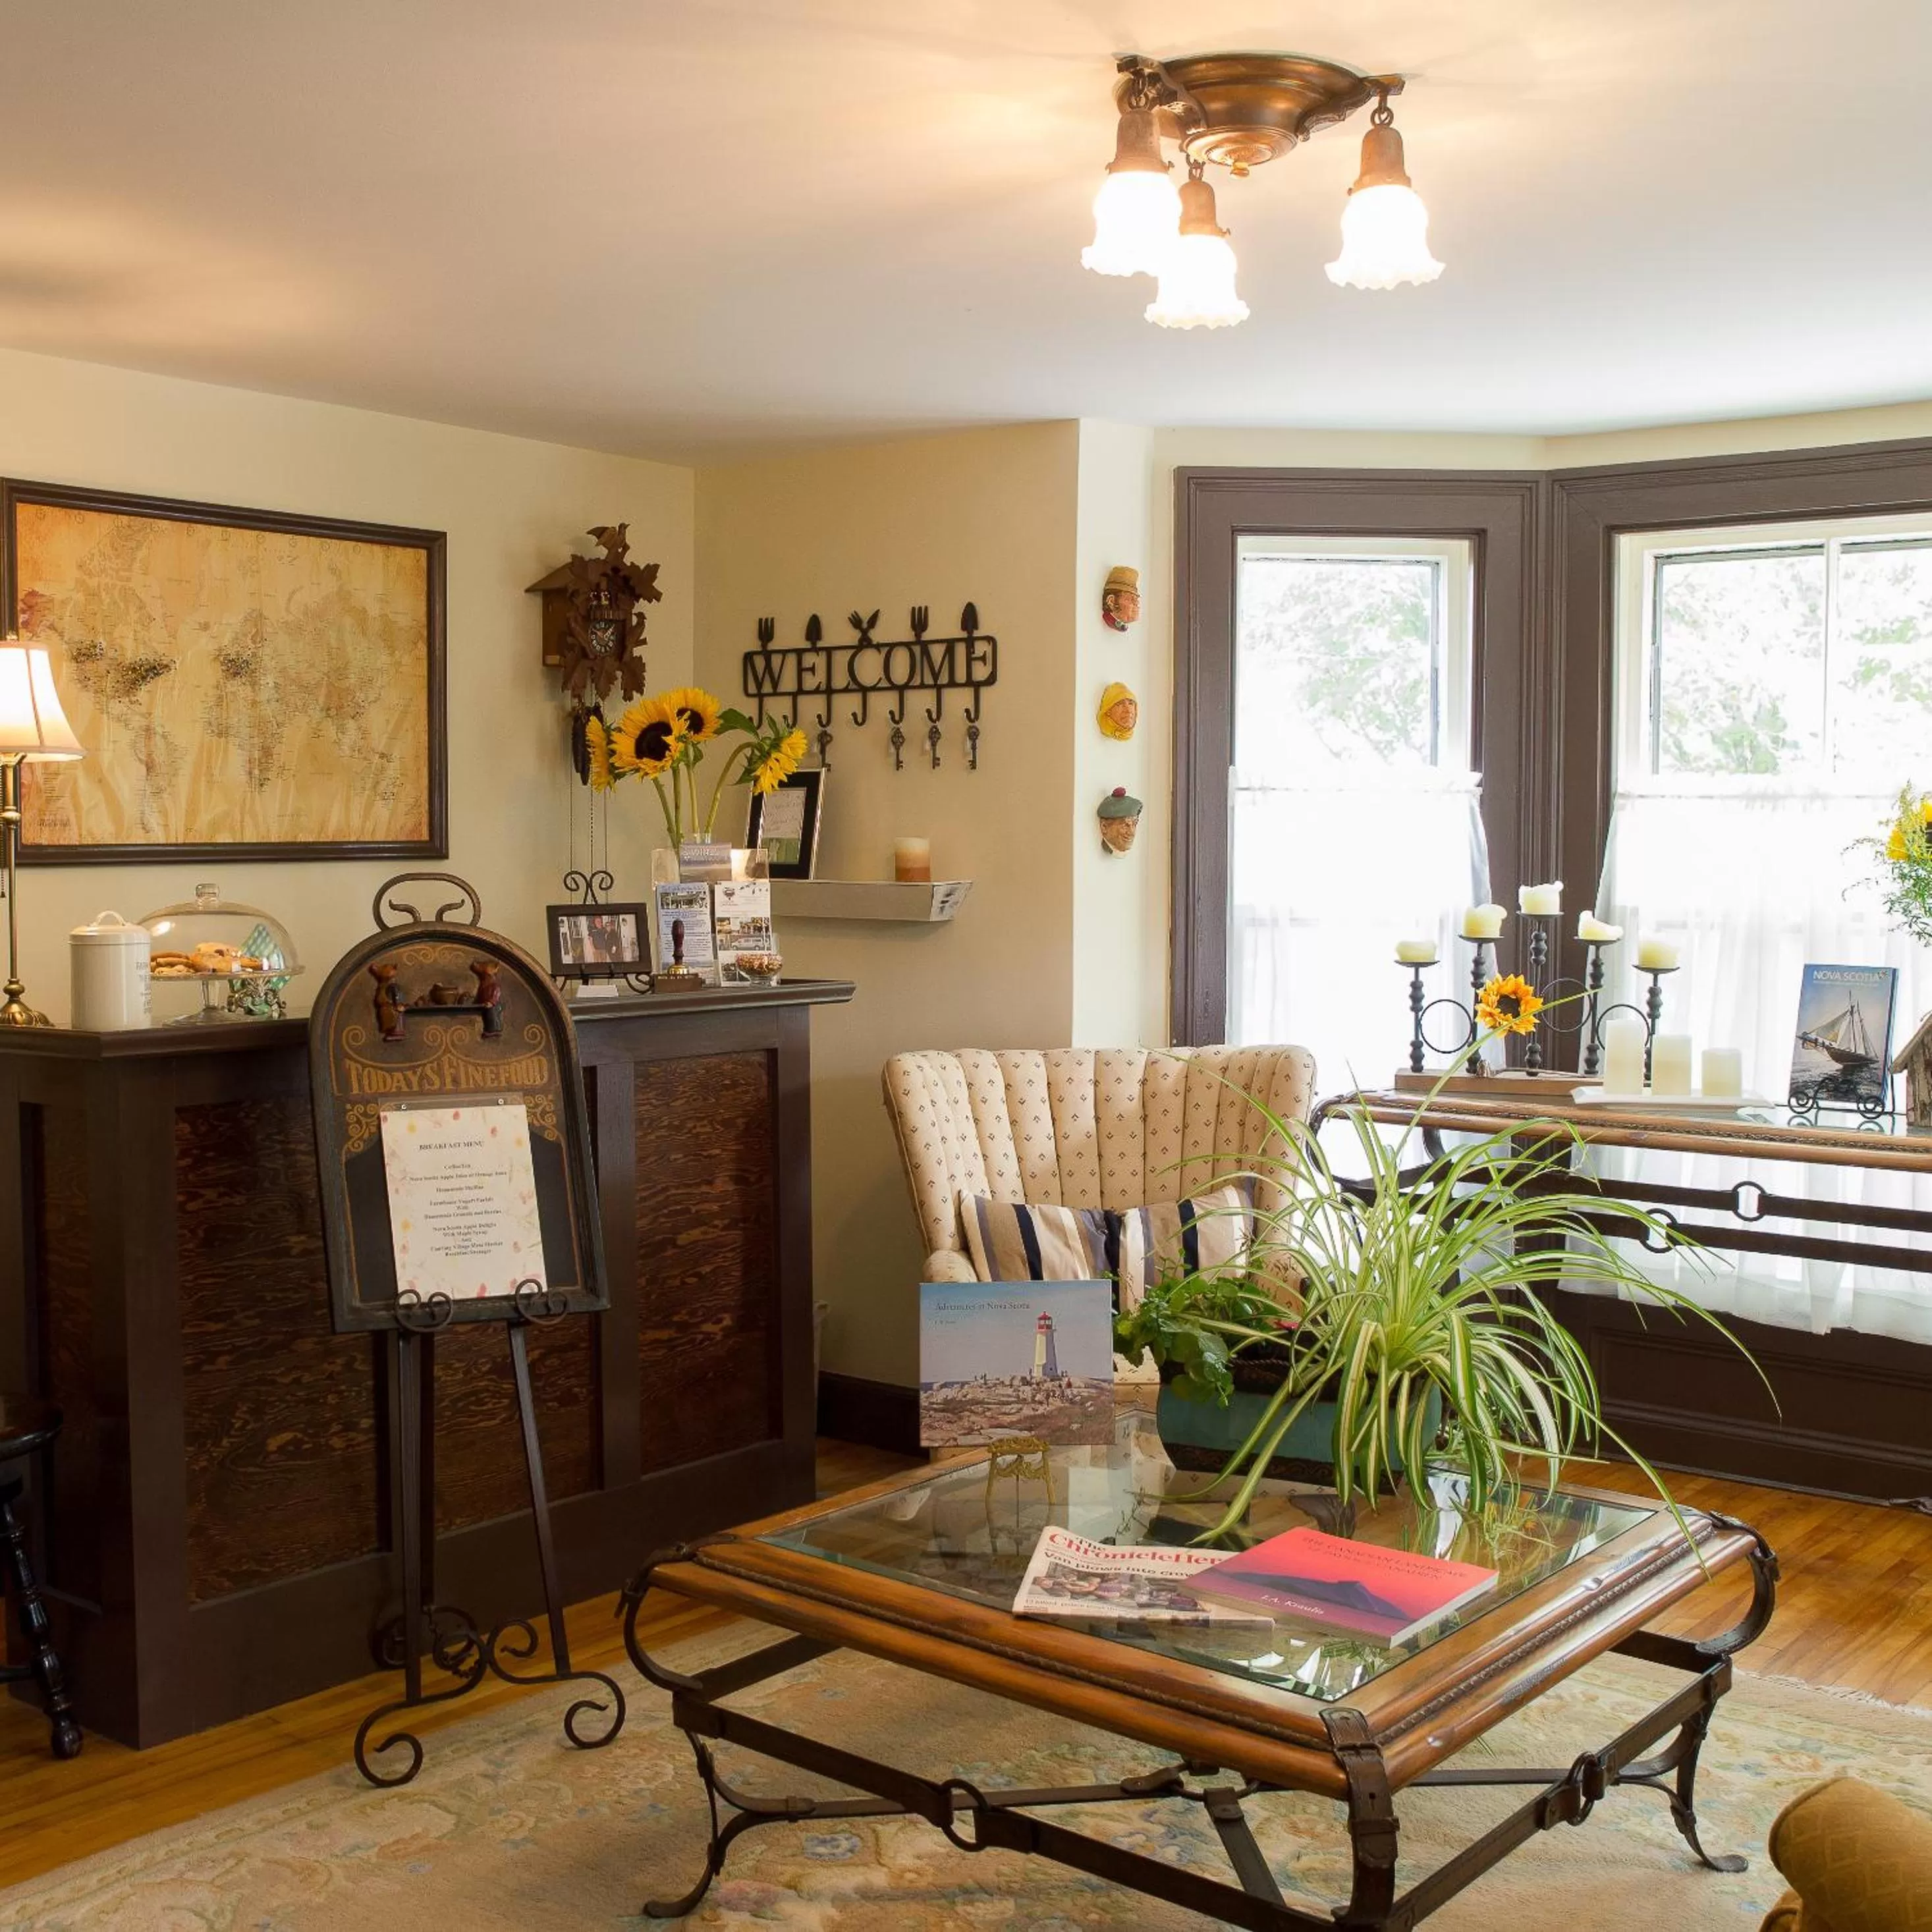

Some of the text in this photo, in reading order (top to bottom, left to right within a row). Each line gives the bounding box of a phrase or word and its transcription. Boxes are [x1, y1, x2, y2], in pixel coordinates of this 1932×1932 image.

[746, 638, 995, 695] WELCOME
[1813, 970, 1879, 981] NOVA SCOTIA
[441, 1055, 496, 1090] FINE
[498, 1055, 549, 1087] FOOD
[419, 1142, 461, 1151] BREAKFAST
[1049, 1533, 1223, 1566] ChronicleHer
[1076, 1536, 1106, 1551] The
[1044, 1551, 1072, 1565] Van
[1075, 1562, 1122, 1572] plows
[1160, 1570, 1194, 1579] crow
